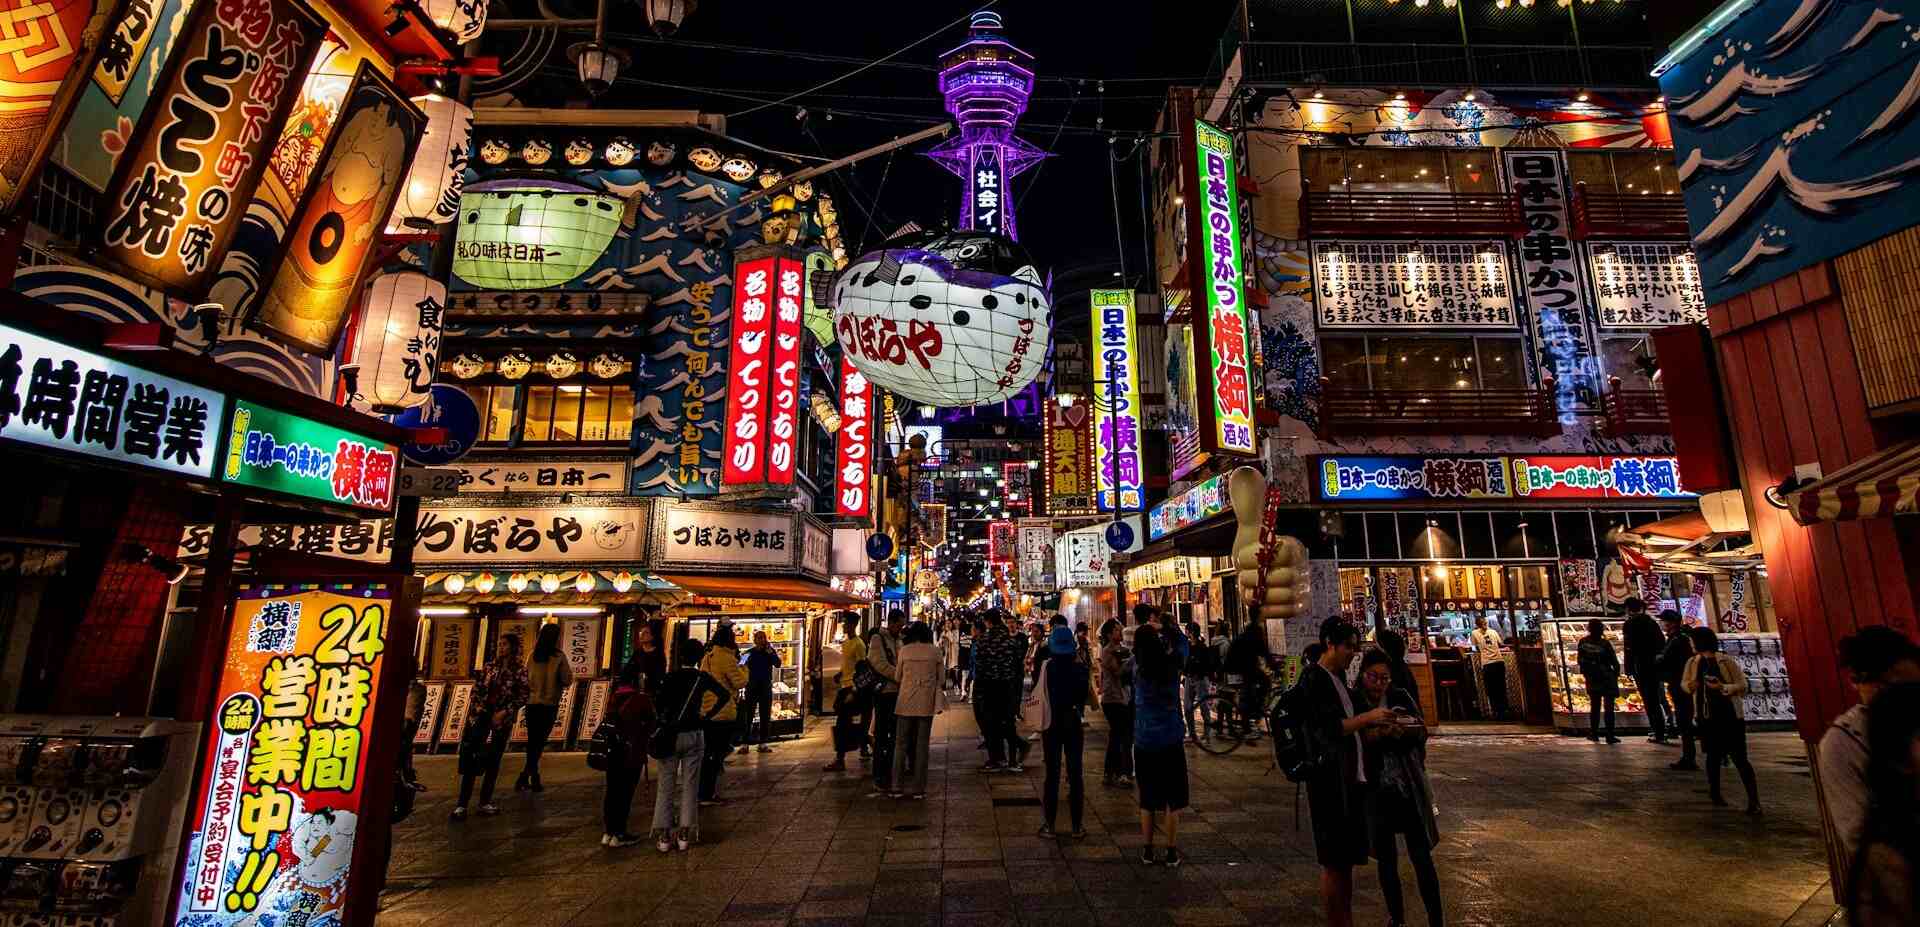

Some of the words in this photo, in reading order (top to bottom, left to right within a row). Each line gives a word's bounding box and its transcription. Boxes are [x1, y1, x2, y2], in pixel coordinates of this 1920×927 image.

[1206, 154, 1237, 306] 日本一の串かつ
[1512, 156, 1577, 307] 日本一の串かつ
[457, 241, 562, 262] 私の味は日本一
[1321, 282, 1336, 323] もち
[1361, 282, 1376, 323] にんにく
[1414, 282, 1430, 323] れんこん
[1613, 283, 1630, 323] キス
[1639, 283, 1655, 323] サーモン
[1652, 283, 1668, 323] たこ
[1664, 283, 1682, 323] いか
[1102, 309, 1130, 412] 日本一の串かつ
[1212, 309, 1251, 419] 横綱
[733, 360, 763, 473] てっちり
[770, 360, 797, 472] てっちり
[244, 431, 332, 481] 日本一の串かつ
[331, 438, 395, 508] 横綱
[1053, 429, 1078, 494] 通天閣
[1099, 415, 1140, 487] 横綱
[432, 475, 456, 492] 22
[1339, 467, 1424, 488] 日本一の串かつ
[1424, 460, 1487, 495] 横綱
[1529, 467, 1613, 488] 日本一の串かつ
[1613, 460, 1676, 494] 横綱
[415, 512, 583, 553] づぼらや
[674, 526, 786, 550] づぼらや本店
[257, 601, 291, 651] 横綱
[223, 714, 252, 730] 時間
[225, 699, 254, 715] 24
[197, 737, 244, 907] 各種宴会予約受付中
